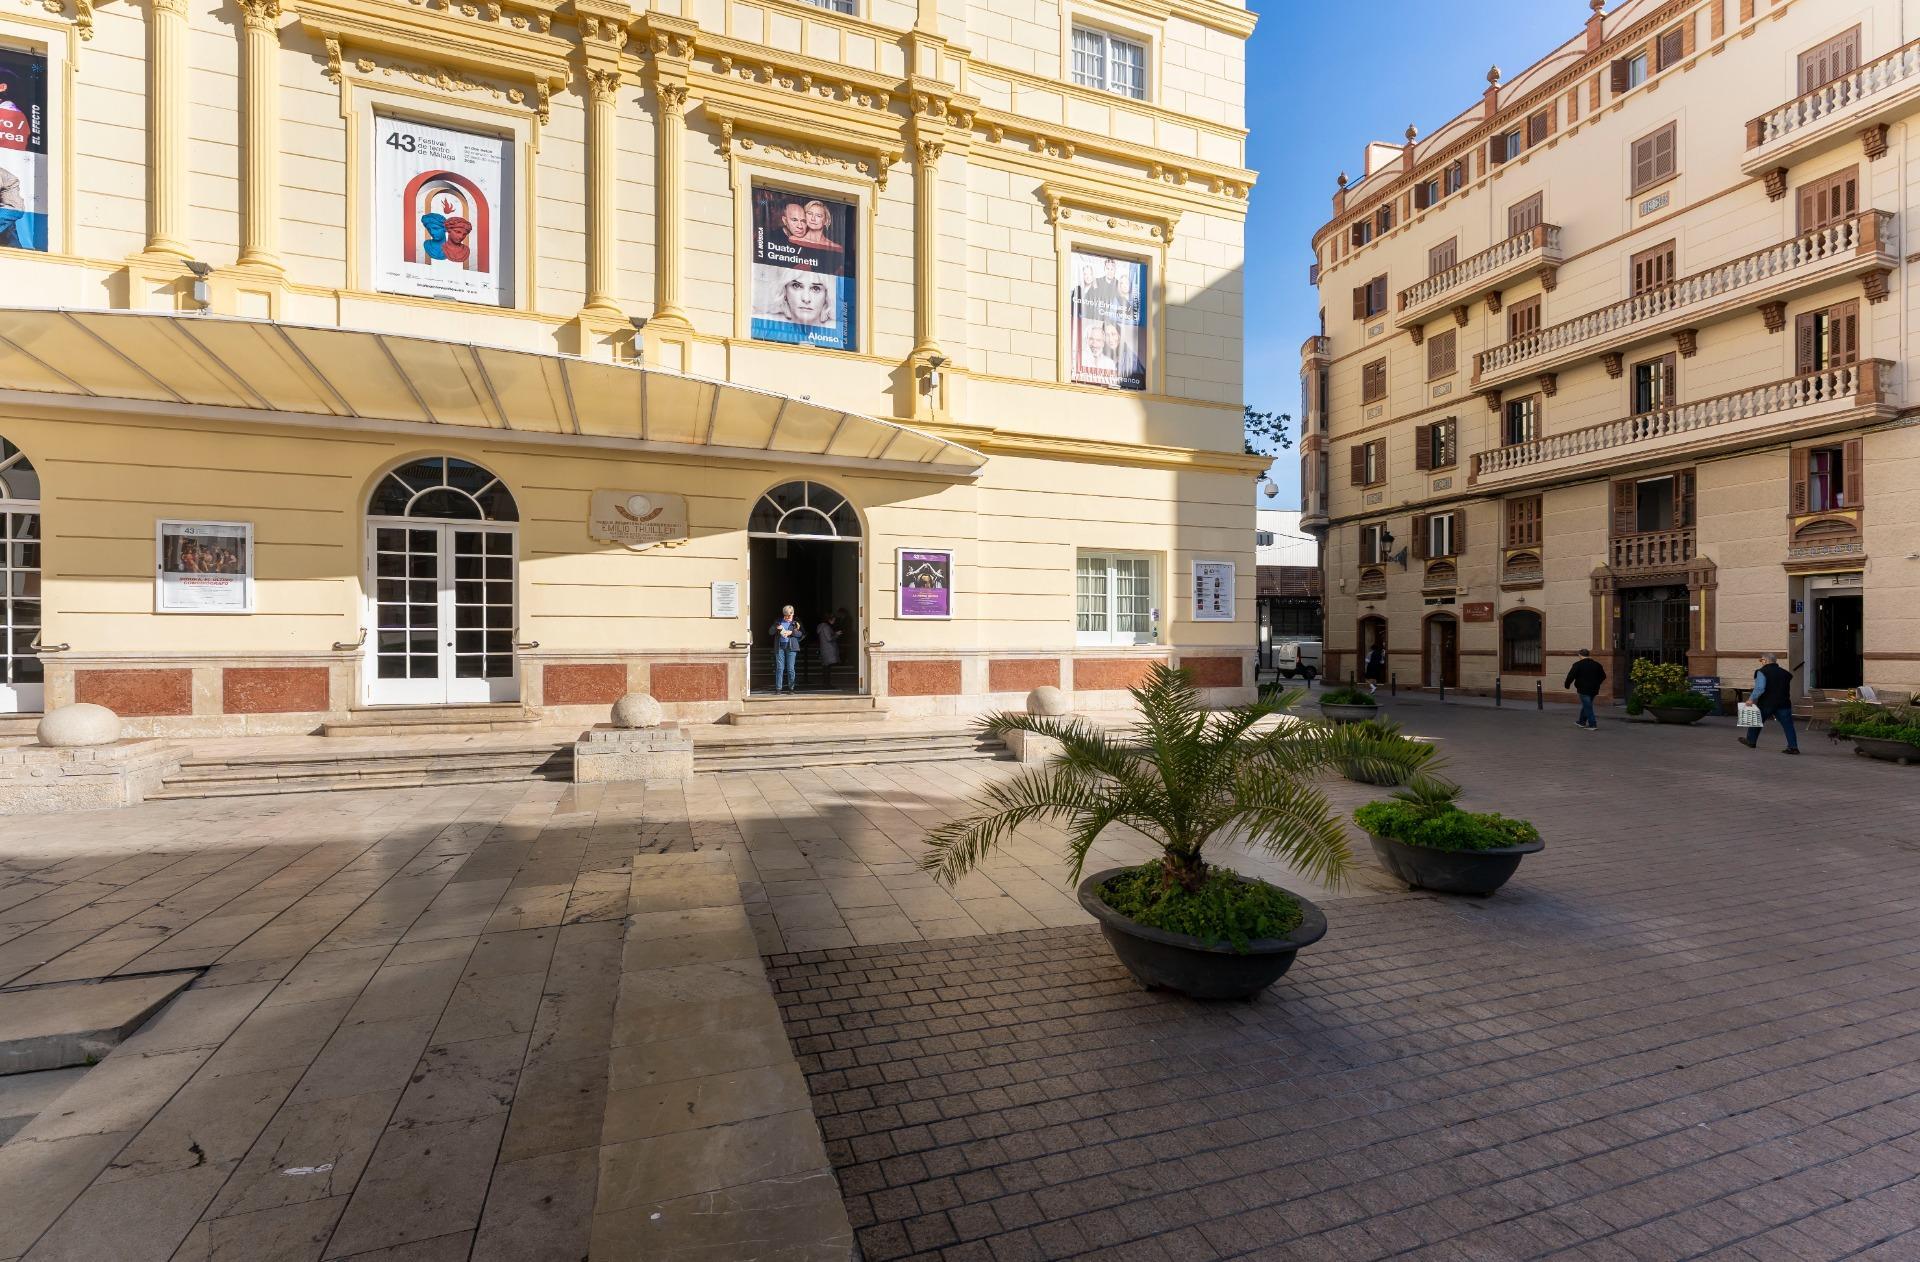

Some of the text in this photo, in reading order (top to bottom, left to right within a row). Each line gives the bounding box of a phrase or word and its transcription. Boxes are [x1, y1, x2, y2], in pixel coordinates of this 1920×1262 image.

[32, 105, 41, 145] EL EFECTO
[386, 132, 447, 153] 43 Festival
[757, 250, 764, 258] LA
[767, 242, 796, 254] Duato
[767, 252, 819, 267] Grandinetti
[808, 331, 839, 343] Alonso
